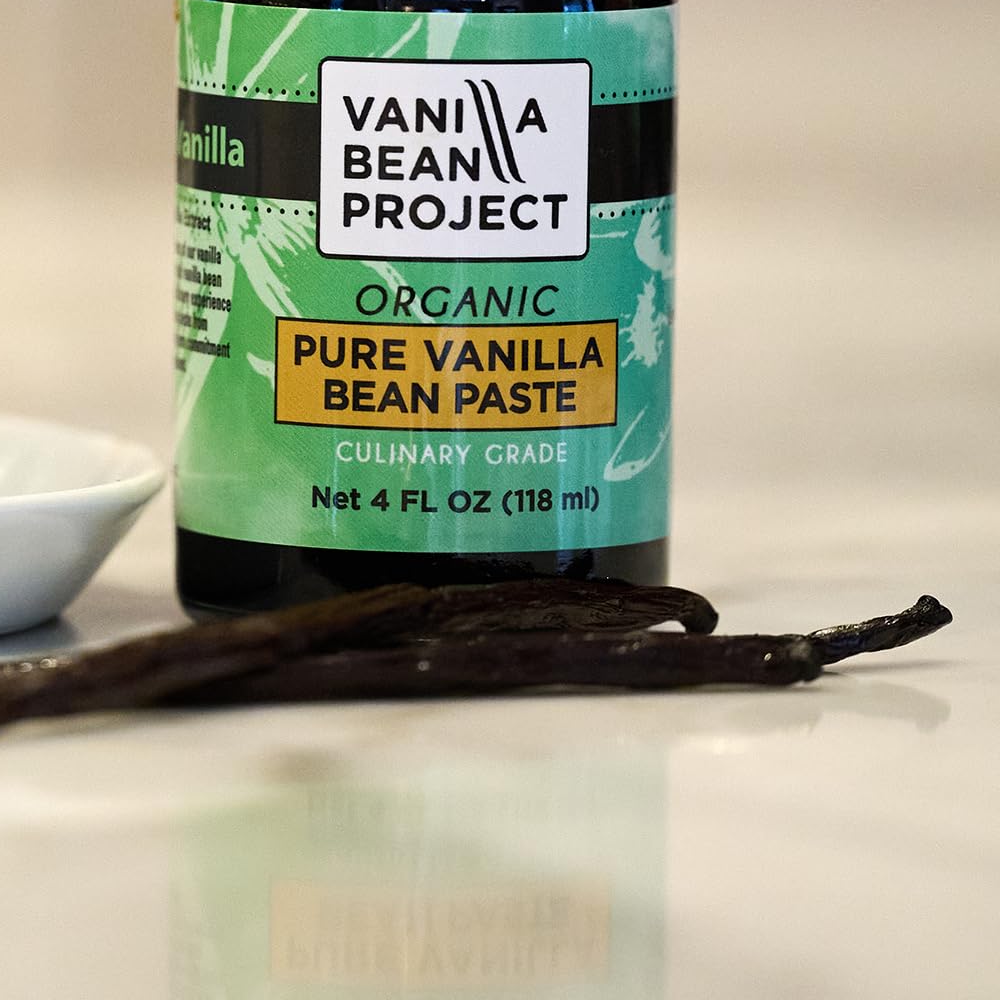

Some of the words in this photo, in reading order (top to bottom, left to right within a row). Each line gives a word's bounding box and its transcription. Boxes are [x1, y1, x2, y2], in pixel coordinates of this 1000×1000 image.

[343, 79, 548, 184] VANILLA
[343, 144, 481, 182] BEAN
[342, 192, 569, 231] PROJECT
[355, 284, 560, 318] ORGANIC
[293, 333, 407, 371] PURE
[423, 336, 605, 372] VANILLA
[323, 378, 440, 415] BEAN
[454, 379, 577, 415] PASTE
[335, 440, 472, 465] CULINARY
[484, 441, 568, 465] GRADE
[311, 485, 361, 511] Net
[370, 488, 390, 512] 4
[400, 489, 438, 513] FL
[447, 489, 492, 513] OZ
[501, 487, 554, 517] (118
[561, 485, 600, 513] ml)
